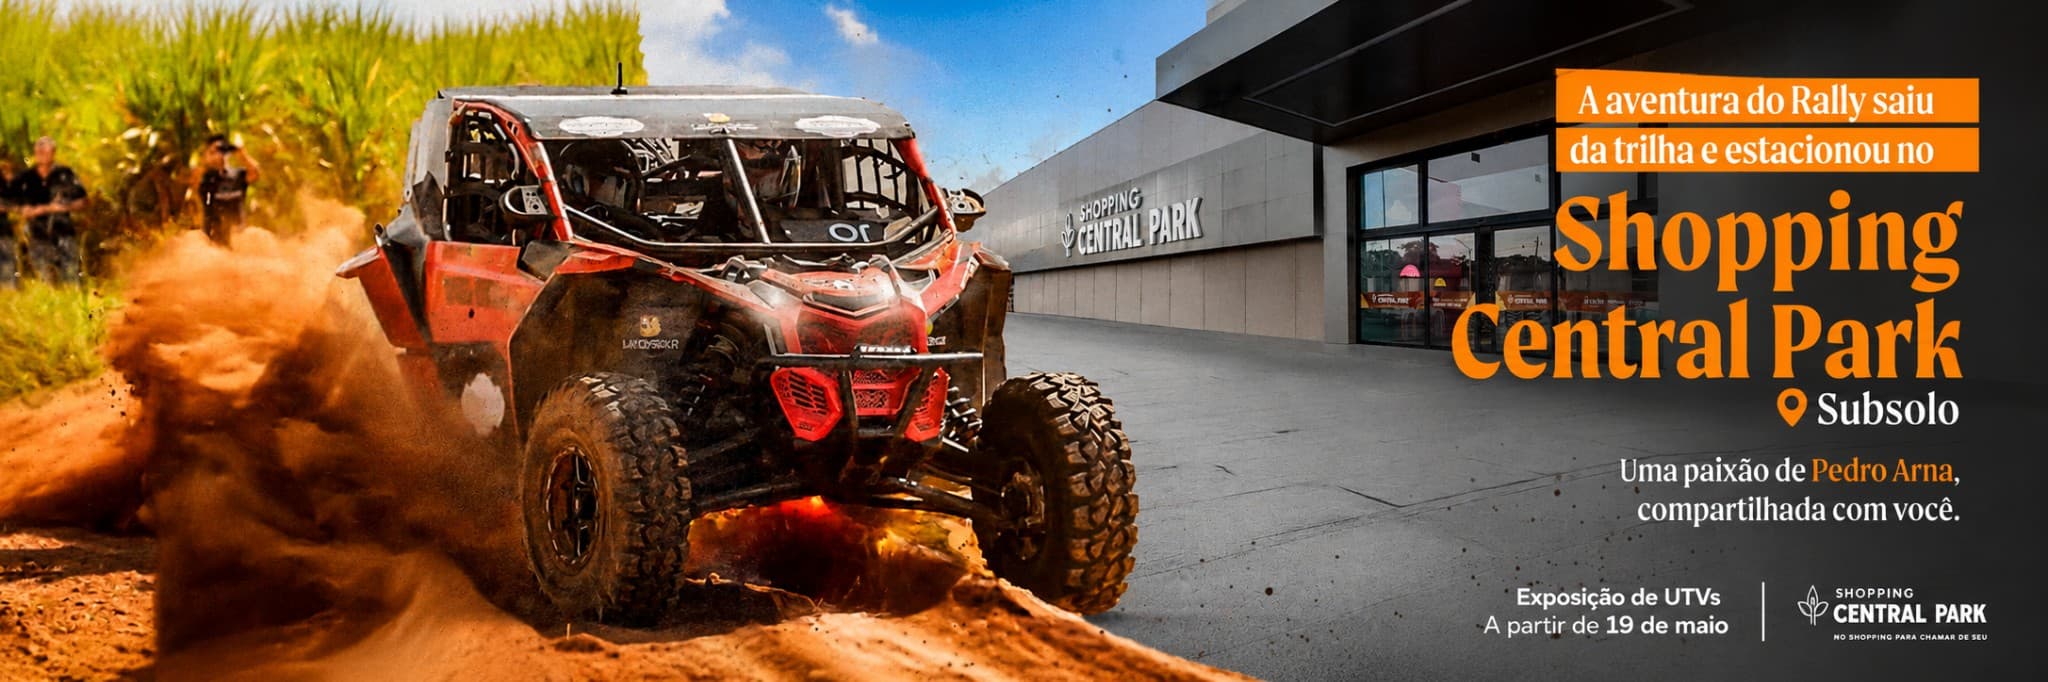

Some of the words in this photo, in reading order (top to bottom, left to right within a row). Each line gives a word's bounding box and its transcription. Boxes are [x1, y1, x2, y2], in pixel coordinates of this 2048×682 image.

[1077, 213, 1144, 256] CENTRAL
[1149, 197, 1202, 246] PARK
[1079, 187, 1142, 222] SHOPPING
